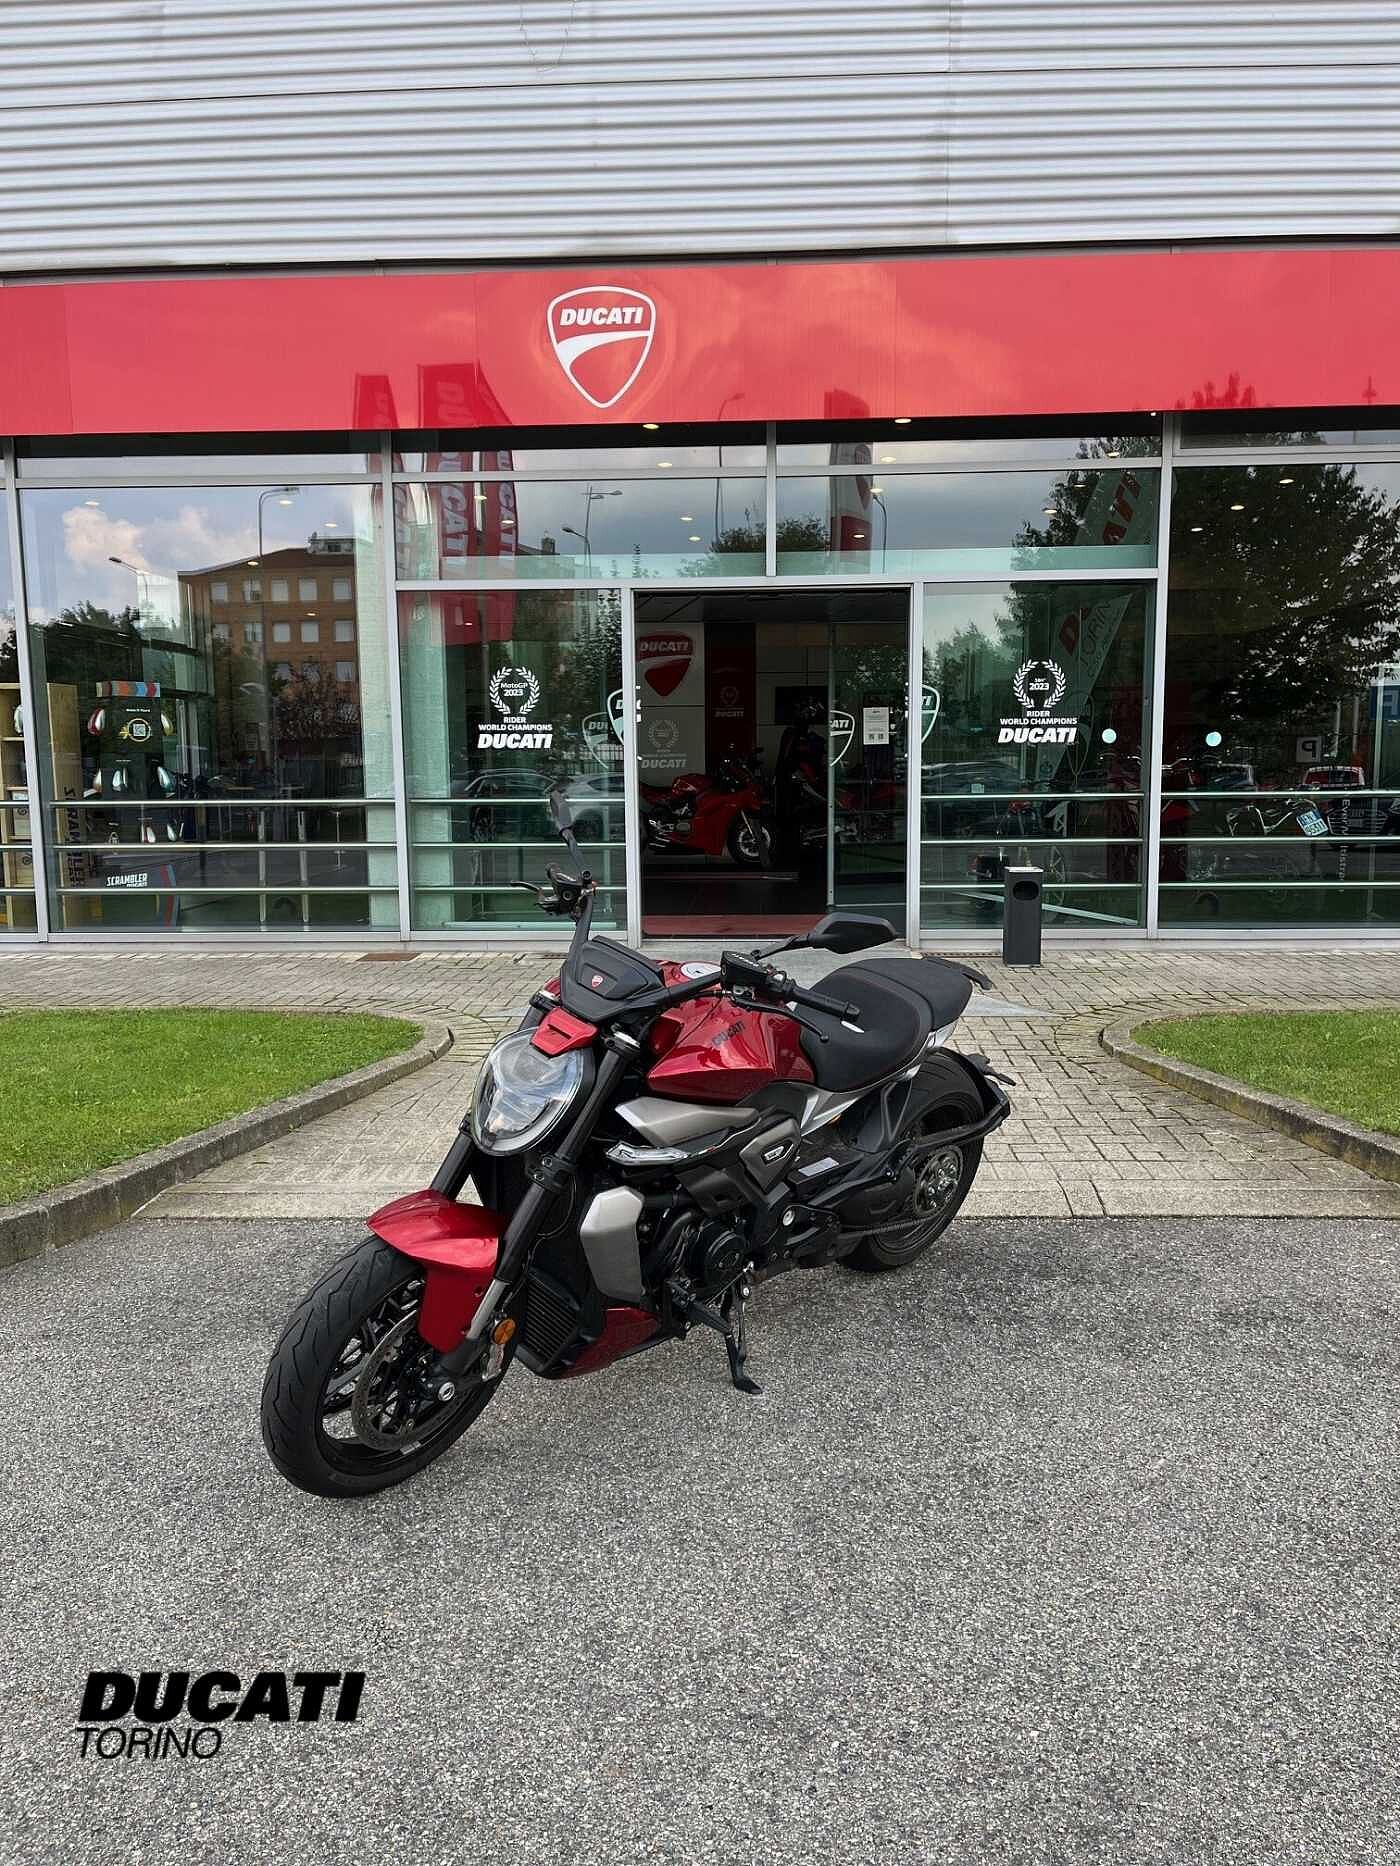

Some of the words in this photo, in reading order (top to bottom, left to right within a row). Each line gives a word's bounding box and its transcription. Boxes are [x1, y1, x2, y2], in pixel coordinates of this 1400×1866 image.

[559, 306, 644, 326] DUCATI
[639, 641, 689, 652] DUCATI
[1028, 682, 1050, 691] 2023
[503, 688, 524, 697] 2023
[1026, 710, 1051, 718] RIDER
[503, 716, 527, 724] RIDER
[1030, 717, 1078, 725] CHAMPIONS
[478, 723, 507, 731] WORLD
[507, 723, 553, 731] CHAMPIONS
[477, 733, 553, 749] DUCATI
[997, 727, 1078, 744] DUCATI
[640, 758, 688, 769] DUCATI
[106, 872, 148, 887] SCRAMBLER
[711, 1019, 746, 1048] DUCATI
